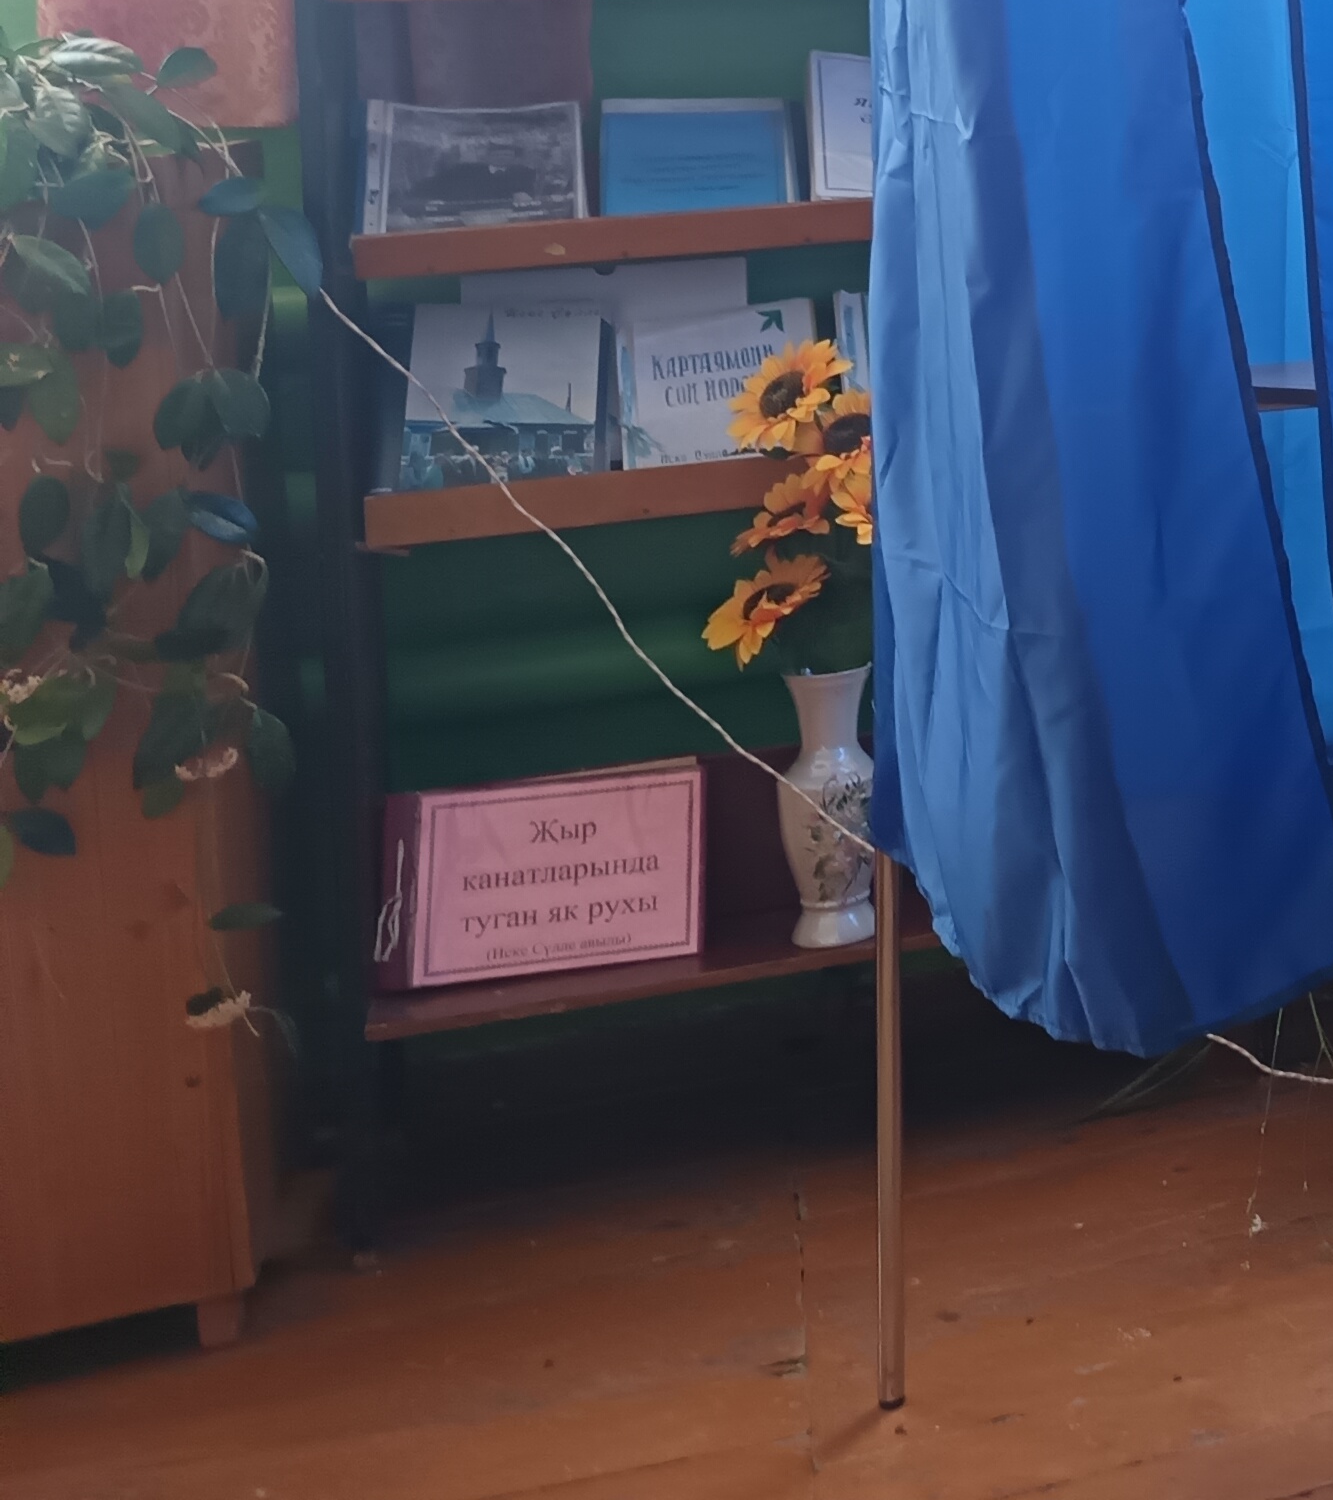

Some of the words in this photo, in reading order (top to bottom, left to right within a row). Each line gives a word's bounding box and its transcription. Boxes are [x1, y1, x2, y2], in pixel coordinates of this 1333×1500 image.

[462, 853, 660, 891] канатларында
[460, 907, 538, 939] туган
[548, 904, 578, 924] як
[588, 894, 659, 925] рухы
